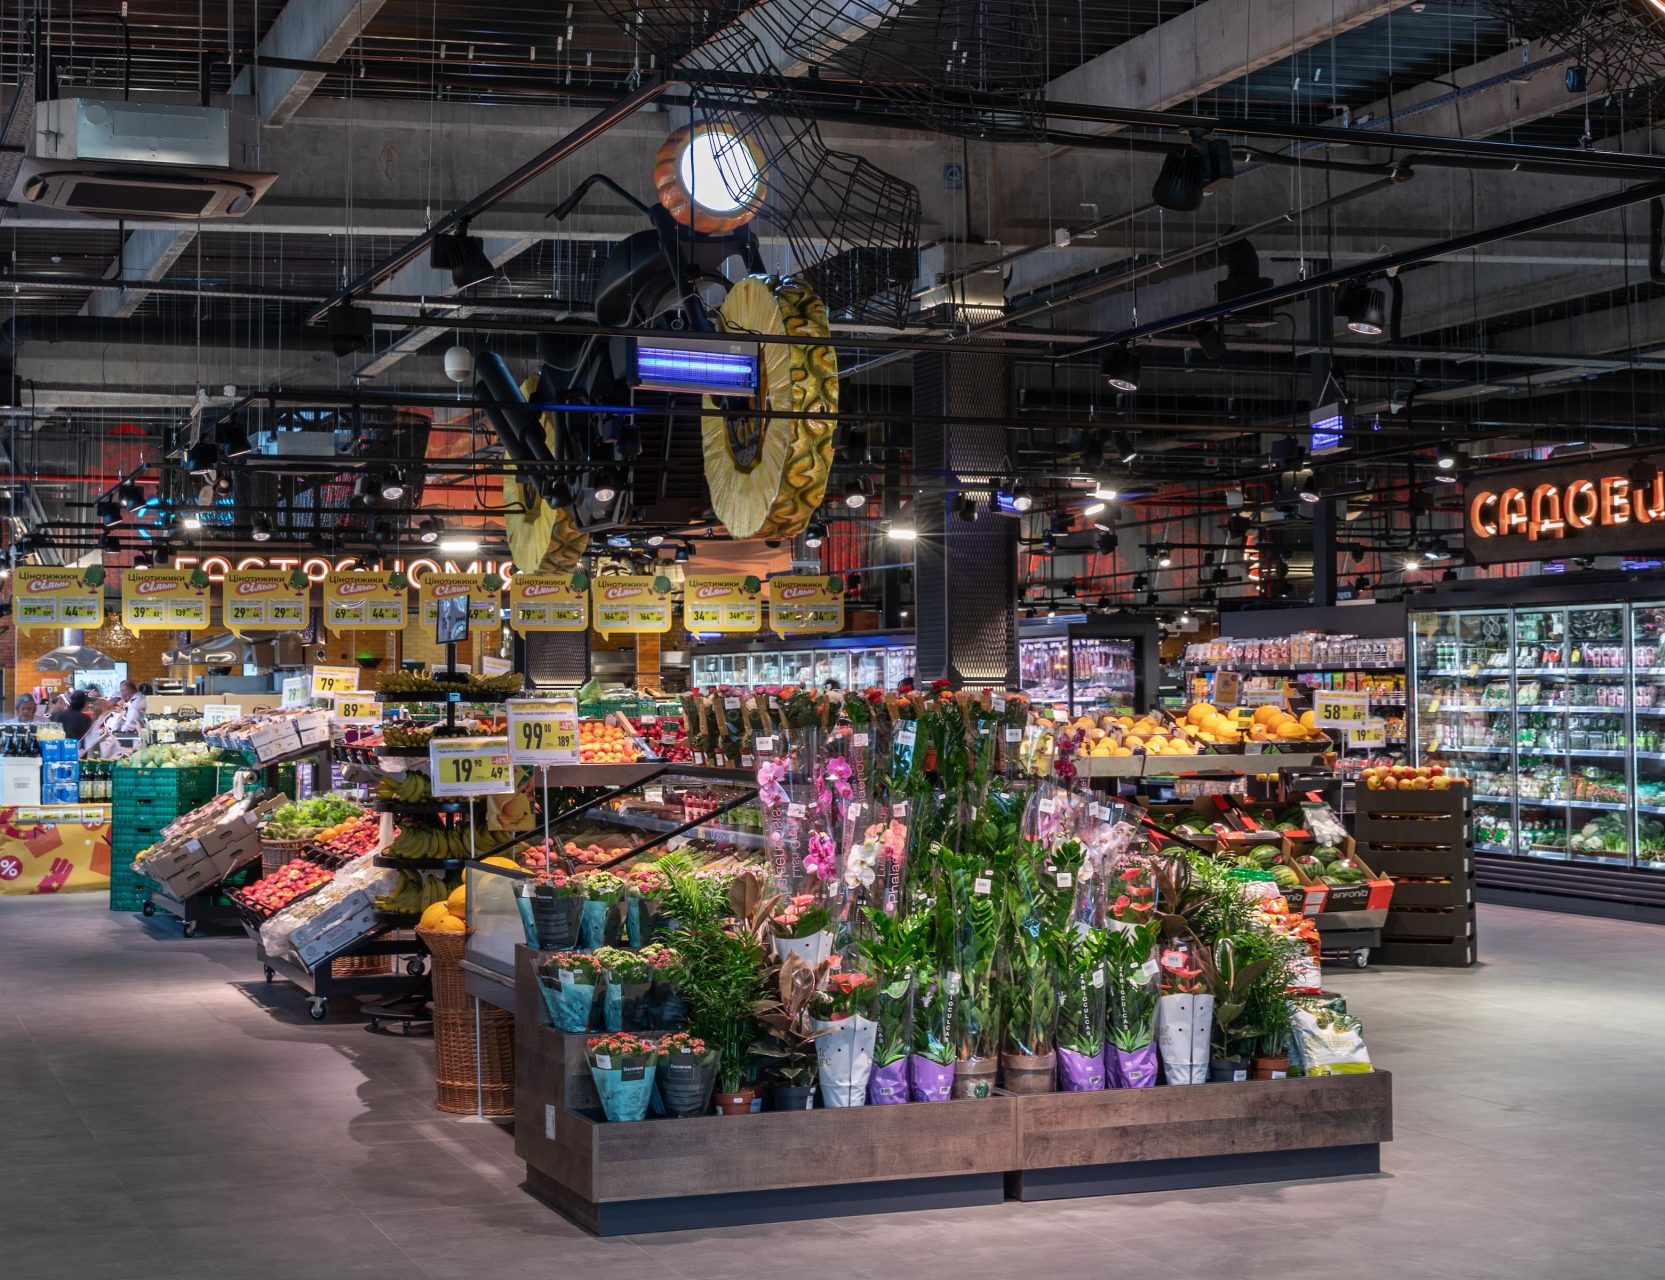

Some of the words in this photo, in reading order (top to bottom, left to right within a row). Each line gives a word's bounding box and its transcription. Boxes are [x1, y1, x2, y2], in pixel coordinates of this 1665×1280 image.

[19, 572, 79, 581] Цінотижики
[128, 574, 185, 583] Цінотижики
[229, 574, 285, 583] Цінотижики
[329, 575, 384, 584] Цінотижики
[425, 577, 478, 586] Цінотижики
[515, 578, 566, 587] Цінотижики
[65, 606, 78, 617] 44
[134, 607, 145, 618] 39
[234, 607, 245, 618] 29
[274, 607, 286, 618] 29
[335, 608, 346, 618] 69
[372, 608, 384, 618] 44
[694, 611, 705, 620] 34
[321, 677, 334, 690] 79
[344, 703, 358, 717] 89
[1324, 704, 1340, 720] 58
[1353, 712, 1361, 720] 69
[523, 722, 542, 750] 99
[1356, 729, 1366, 741] 19
[558, 736, 570, 747] 189
[452, 758, 473, 782] 19
[474, 759, 482, 767] 90
[491, 767, 503, 779] 49
[1080, 973, 1091, 1036] ZAMIOCULCAS
